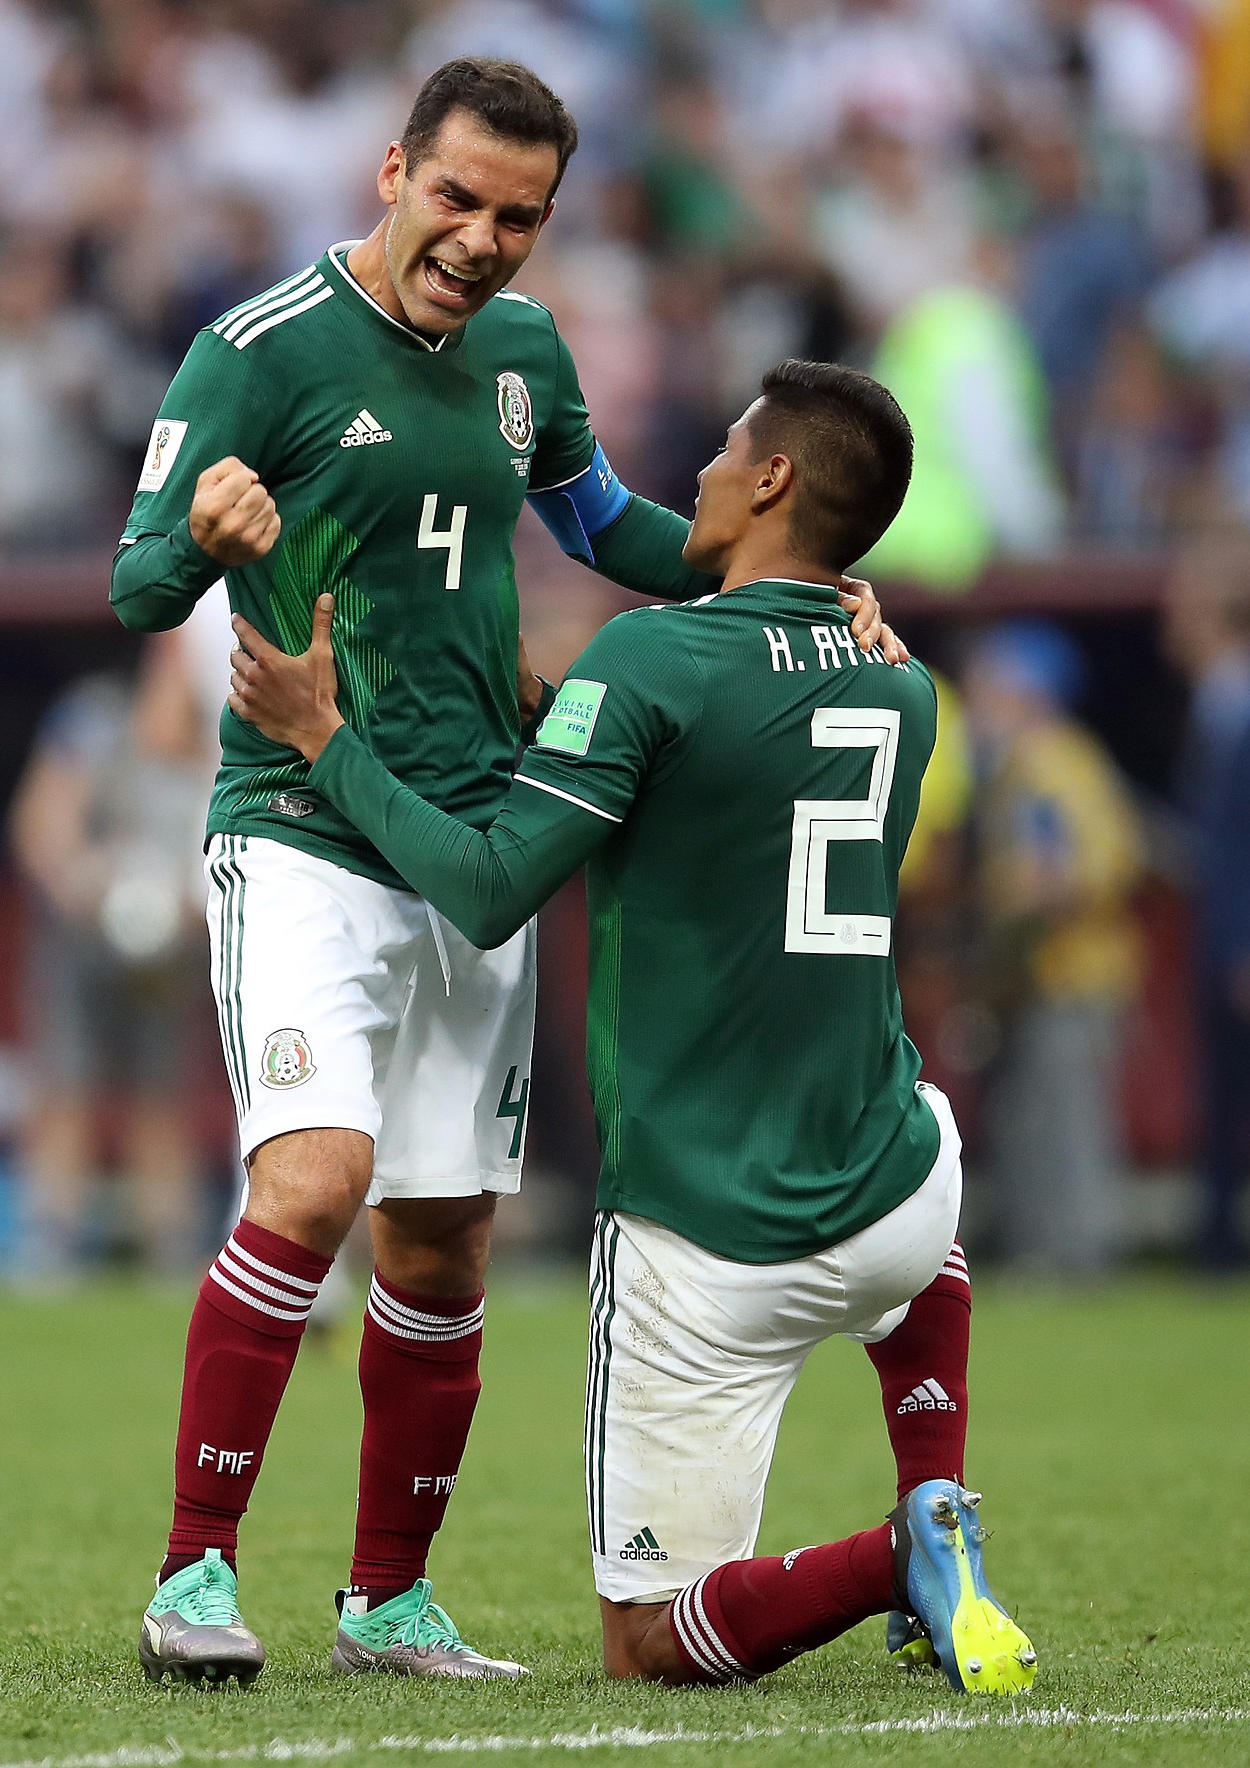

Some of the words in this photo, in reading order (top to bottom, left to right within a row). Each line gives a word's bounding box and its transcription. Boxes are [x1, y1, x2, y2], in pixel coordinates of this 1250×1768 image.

[339, 428, 393, 448] adidas
[417, 493, 468, 590] 4
[762, 626, 805, 672] H.
[567, 723, 586, 735] FIFA
[784, 707, 900, 957] 2
[496, 1065, 529, 1159] 4
[897, 1399, 957, 1415] adidas
[198, 1443, 254, 1475] FMF
[619, 1548, 668, 1562] adidas
